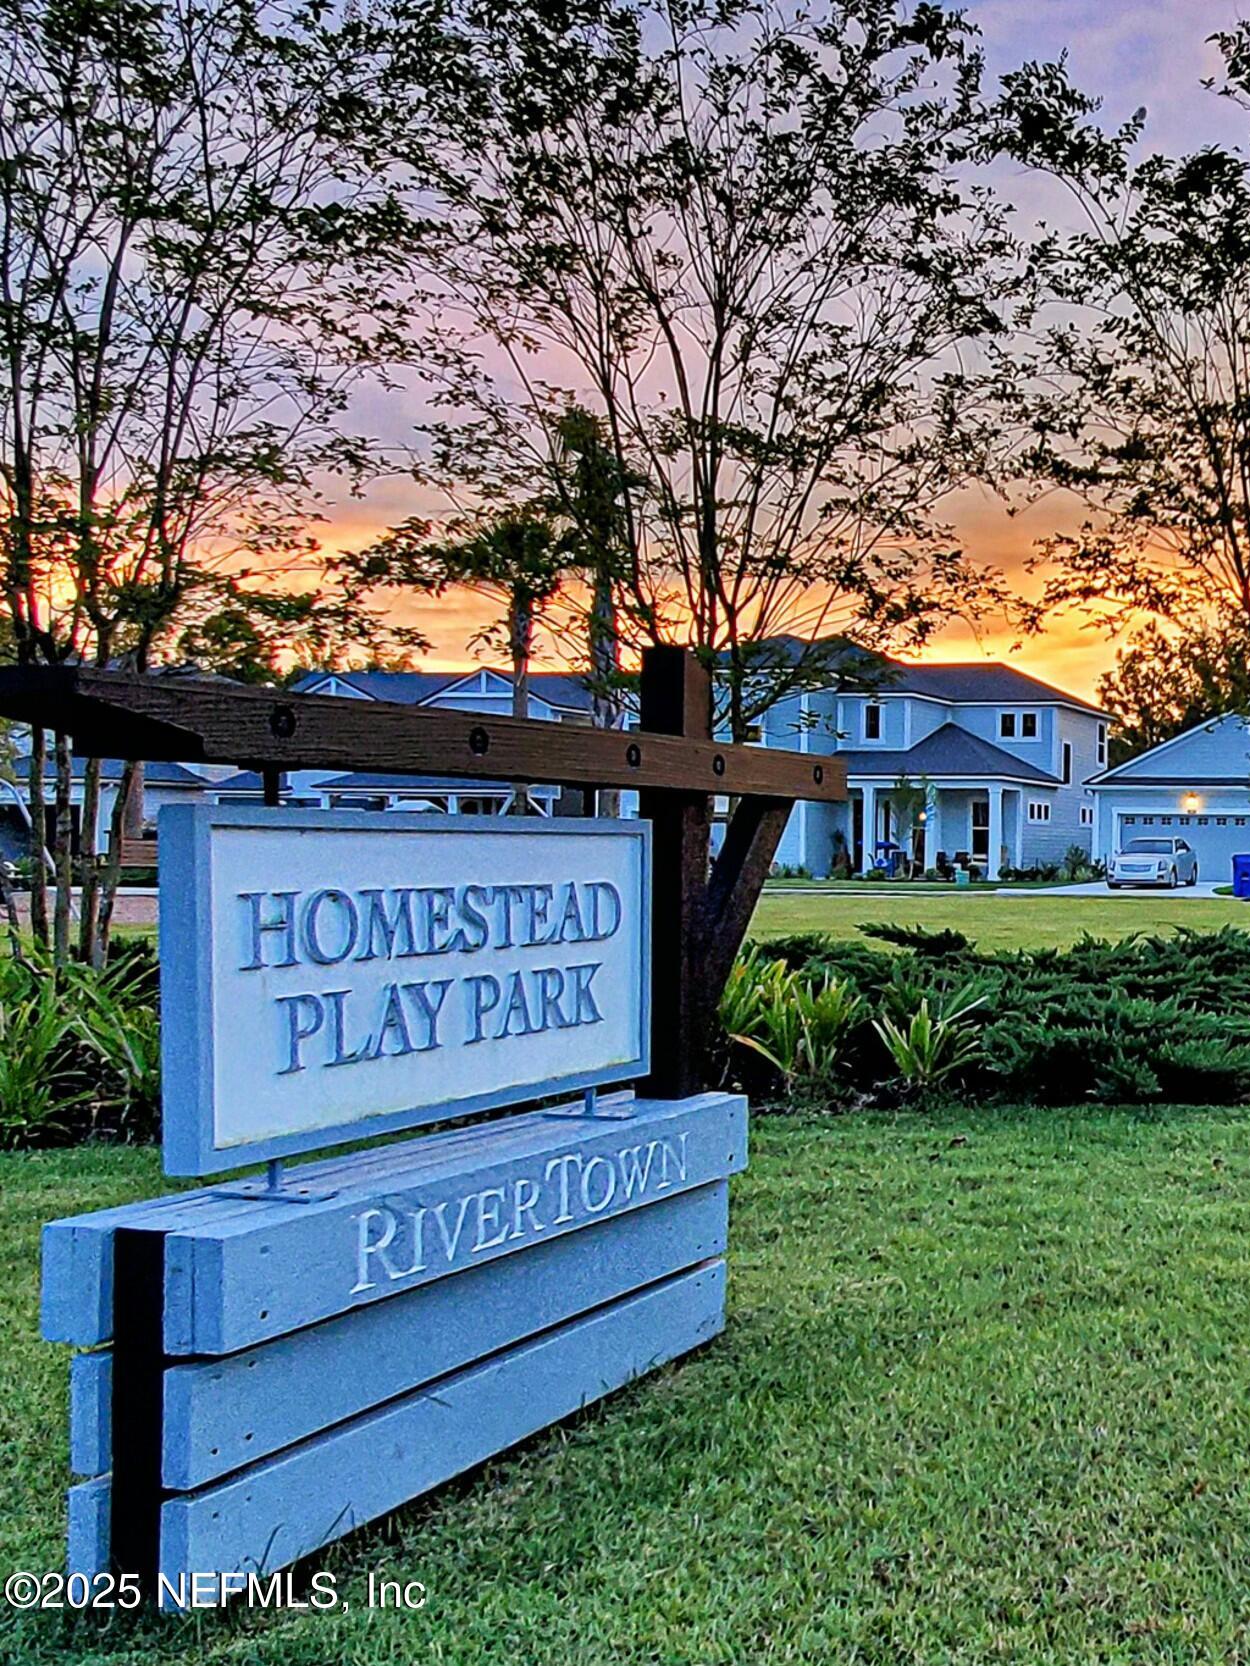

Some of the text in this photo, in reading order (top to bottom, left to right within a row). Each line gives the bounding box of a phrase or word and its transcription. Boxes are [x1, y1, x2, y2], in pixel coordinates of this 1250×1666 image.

[238, 881, 622, 971] HOMESTEAD
[276, 962, 605, 1075] PLAY PARK
[351, 1131, 690, 1293] RIVERTOWN
